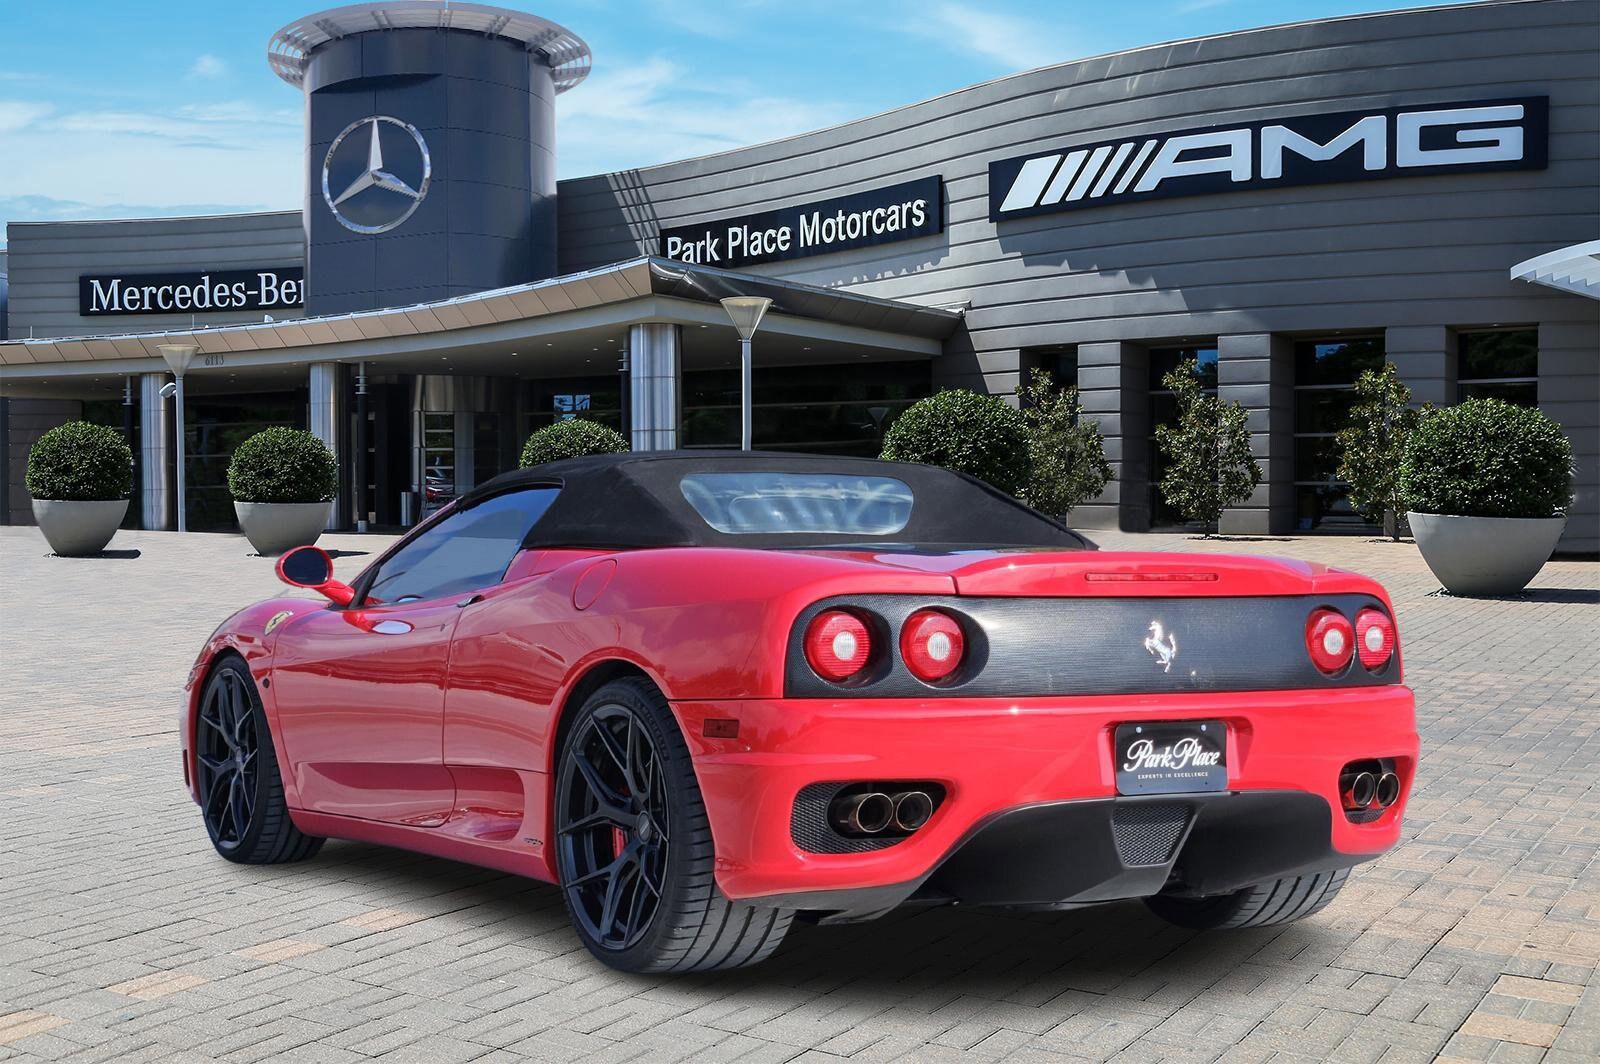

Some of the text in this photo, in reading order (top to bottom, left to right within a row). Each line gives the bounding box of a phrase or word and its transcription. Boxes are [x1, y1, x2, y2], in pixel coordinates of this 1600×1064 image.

[667, 198, 926, 264] Park Place Motorcars
[1123, 737, 1220, 772] Park Place
